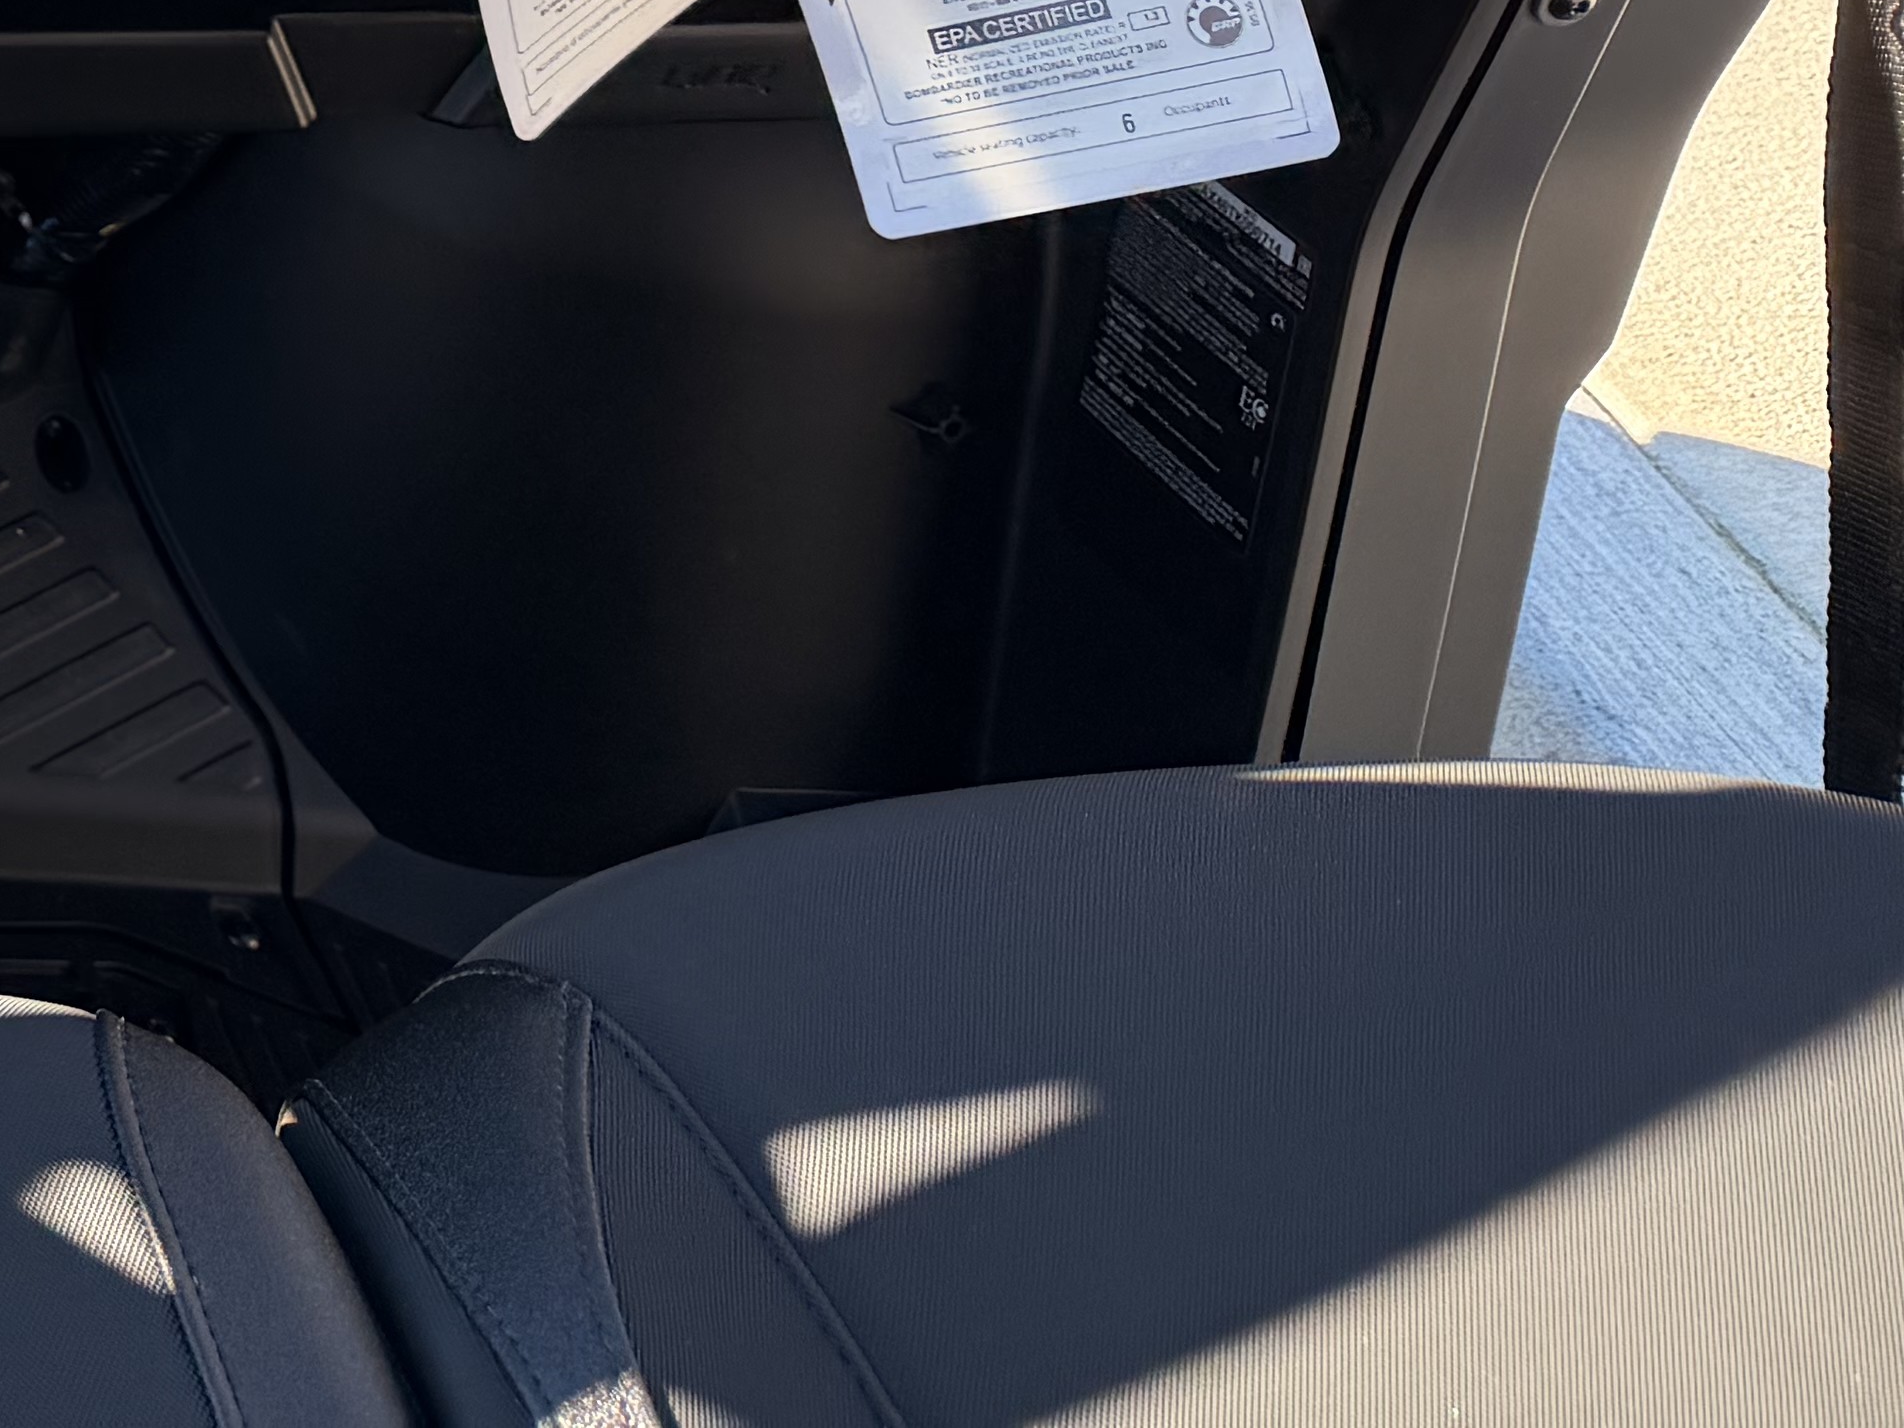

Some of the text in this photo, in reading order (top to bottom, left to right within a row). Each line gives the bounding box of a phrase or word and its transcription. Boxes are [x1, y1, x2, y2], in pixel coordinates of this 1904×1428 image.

[933, 24, 983, 51] EPA
[903, 75, 983, 101] BOMBARDIER
[984, 58, 1075, 85] RECREATIONAL
[1076, 43, 1144, 65] PRODUCTS
[925, 53, 961, 70] NER
[964, 90, 981, 102] TO
[983, 87, 1000, 98] BE
[1062, 67, 1101, 82] PRIOR
[1121, 112, 1137, 134] 6
